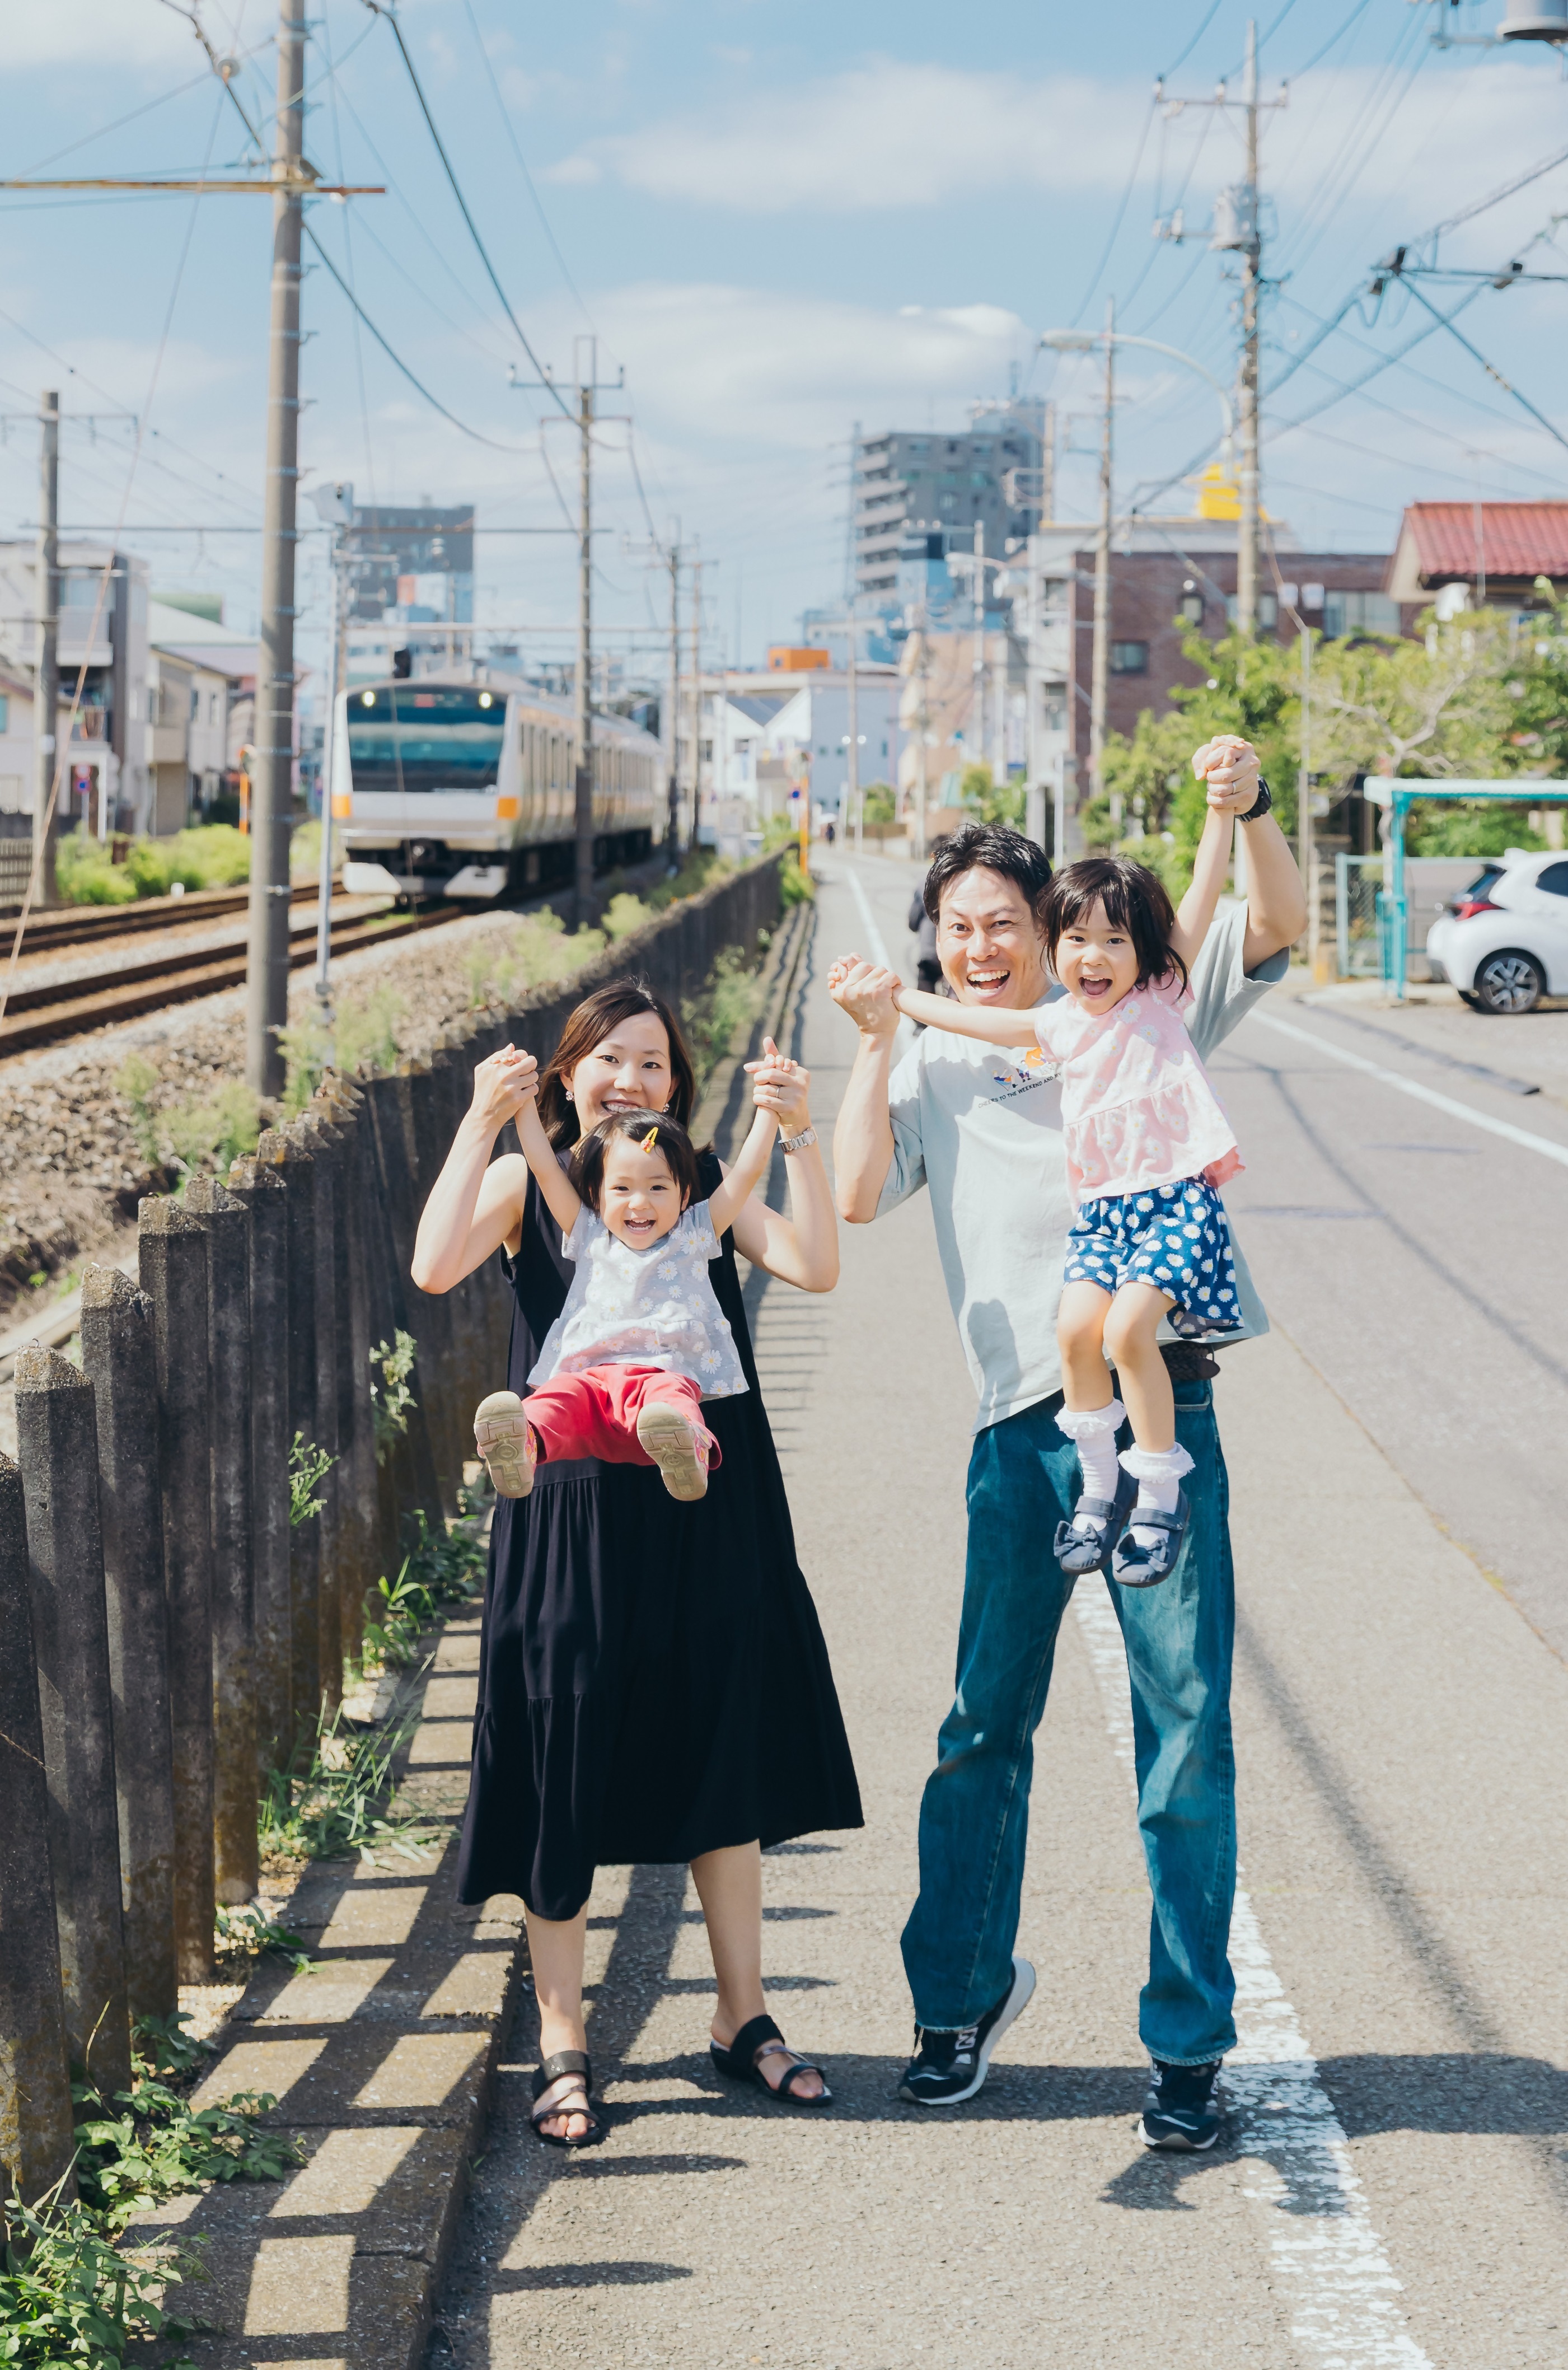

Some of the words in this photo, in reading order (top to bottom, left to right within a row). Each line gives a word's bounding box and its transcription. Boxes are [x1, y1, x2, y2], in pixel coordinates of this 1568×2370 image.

[978, 1097, 999, 1108] CHEERS
[1007, 1091, 1017, 1100] THE
[1018, 1081, 1043, 1094] WEEKEND
